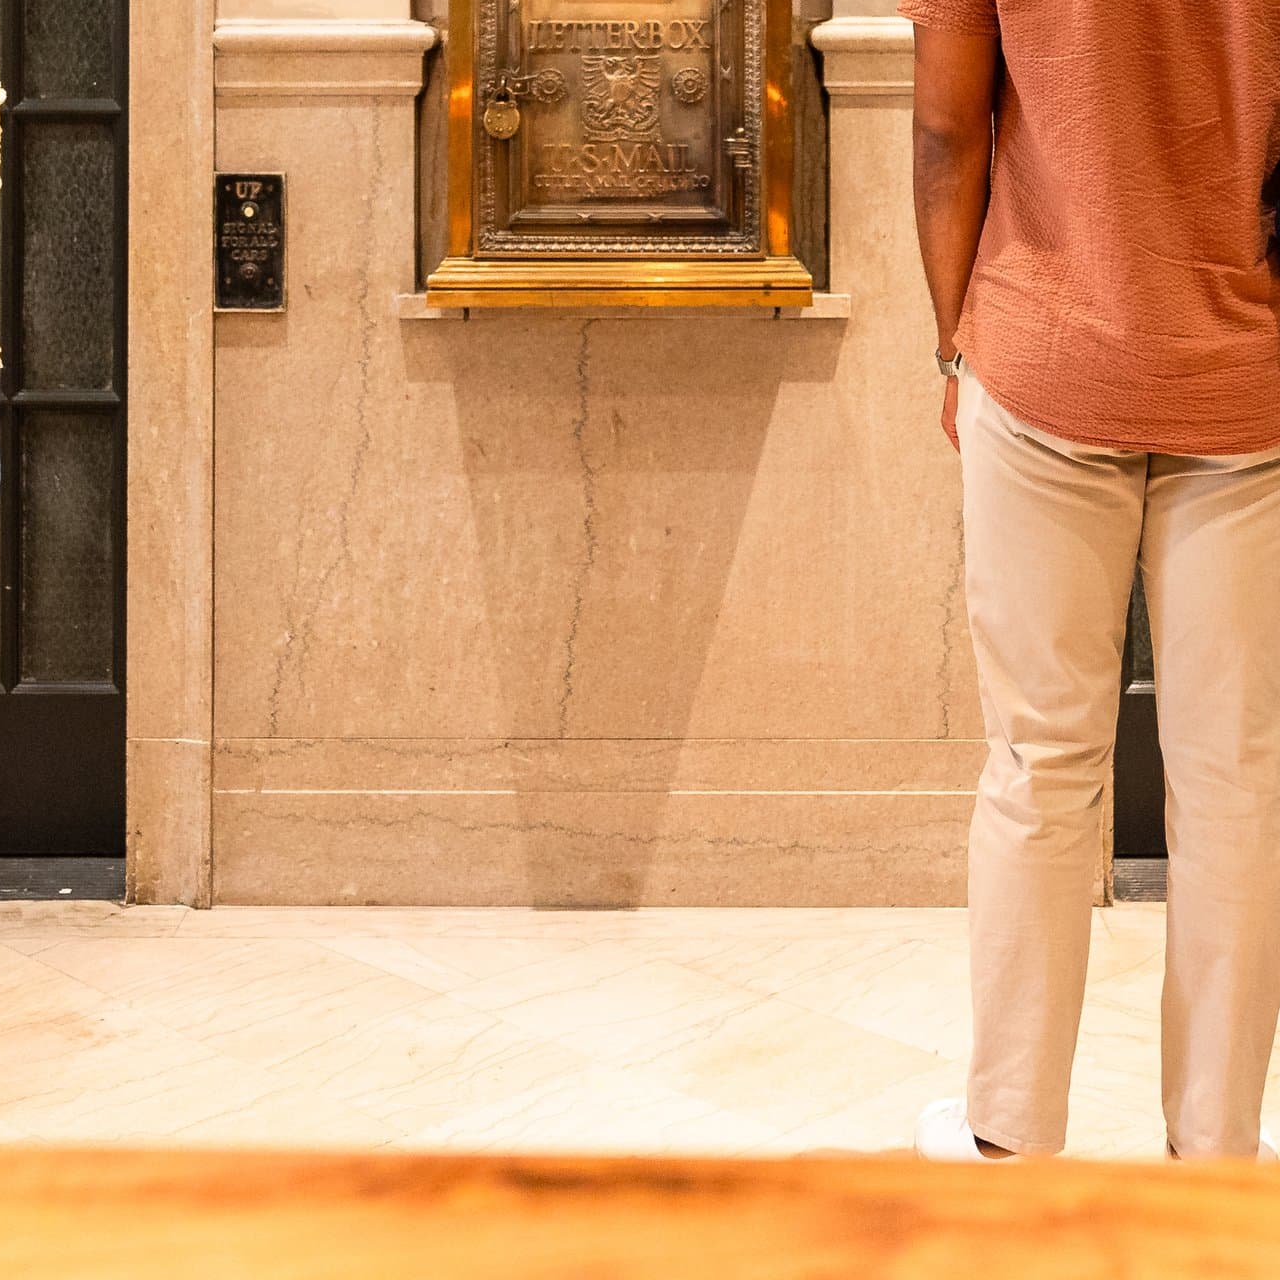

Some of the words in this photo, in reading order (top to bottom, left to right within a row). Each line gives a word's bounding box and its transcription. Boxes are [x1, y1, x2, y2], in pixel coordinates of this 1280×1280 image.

[235, 181, 263, 199] UP
[222, 222, 278, 234] SIGNAL
[221, 236, 248, 248] FOR
[250, 236, 279, 248] ALL
[231, 249, 267, 261] CARS
